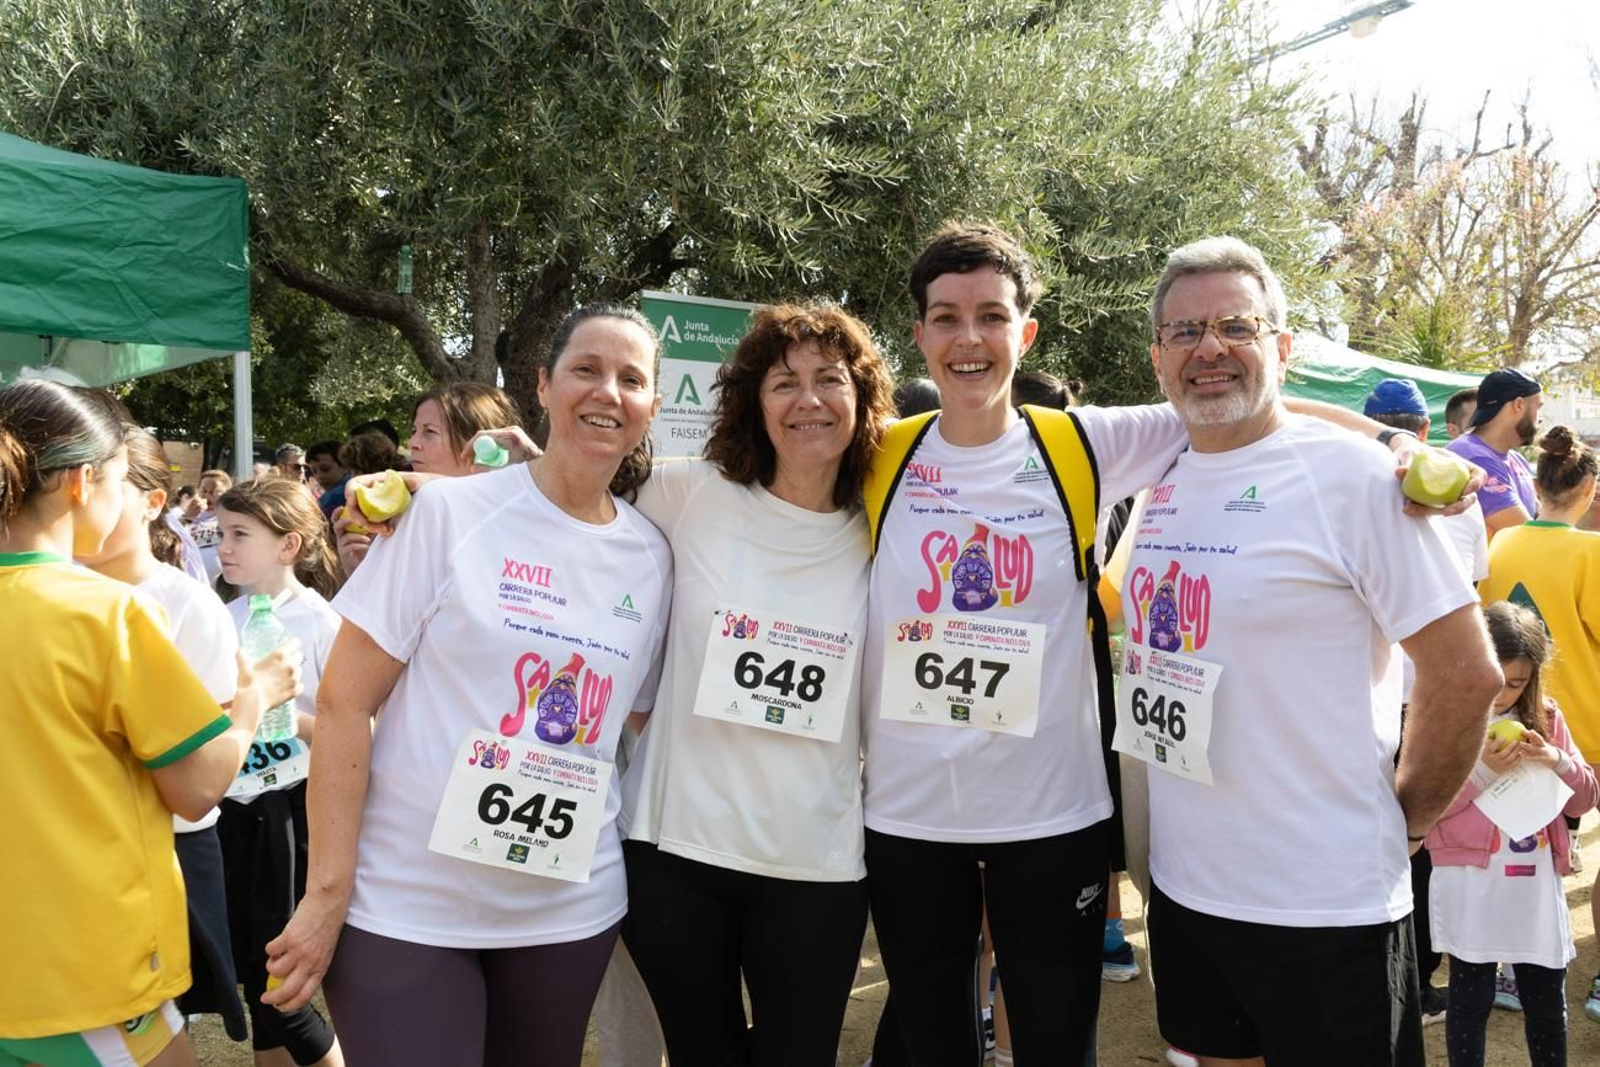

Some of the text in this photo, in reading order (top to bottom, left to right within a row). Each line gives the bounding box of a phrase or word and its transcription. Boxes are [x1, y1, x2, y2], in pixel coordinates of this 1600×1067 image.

[684, 320, 710, 332] Junta
[684, 332, 740, 345] de Andalucía
[660, 406, 678, 415] Junta
[671, 428, 707, 440] FAISEM
[1028, 509, 1044, 518] salud
[500, 557, 554, 587] XXVII
[498, 581, 533, 597] CARRERA
[772, 620, 793, 632] XXVII
[792, 625, 819, 638] CARRERA
[947, 619, 1027, 638] XXVII CARRERA POPULAR
[734, 651, 826, 702] 648
[915, 652, 1010, 698] 647
[751, 693, 802, 710] MOSCARDONA
[1131, 687, 1187, 742] 646
[524, 750, 547, 764] XXVII
[546, 756, 572, 770] CARRERA
[478, 783, 577, 839] 645
[493, 829, 549, 848] ROSA MELANO
[1081, 883, 1100, 900] NIKE
